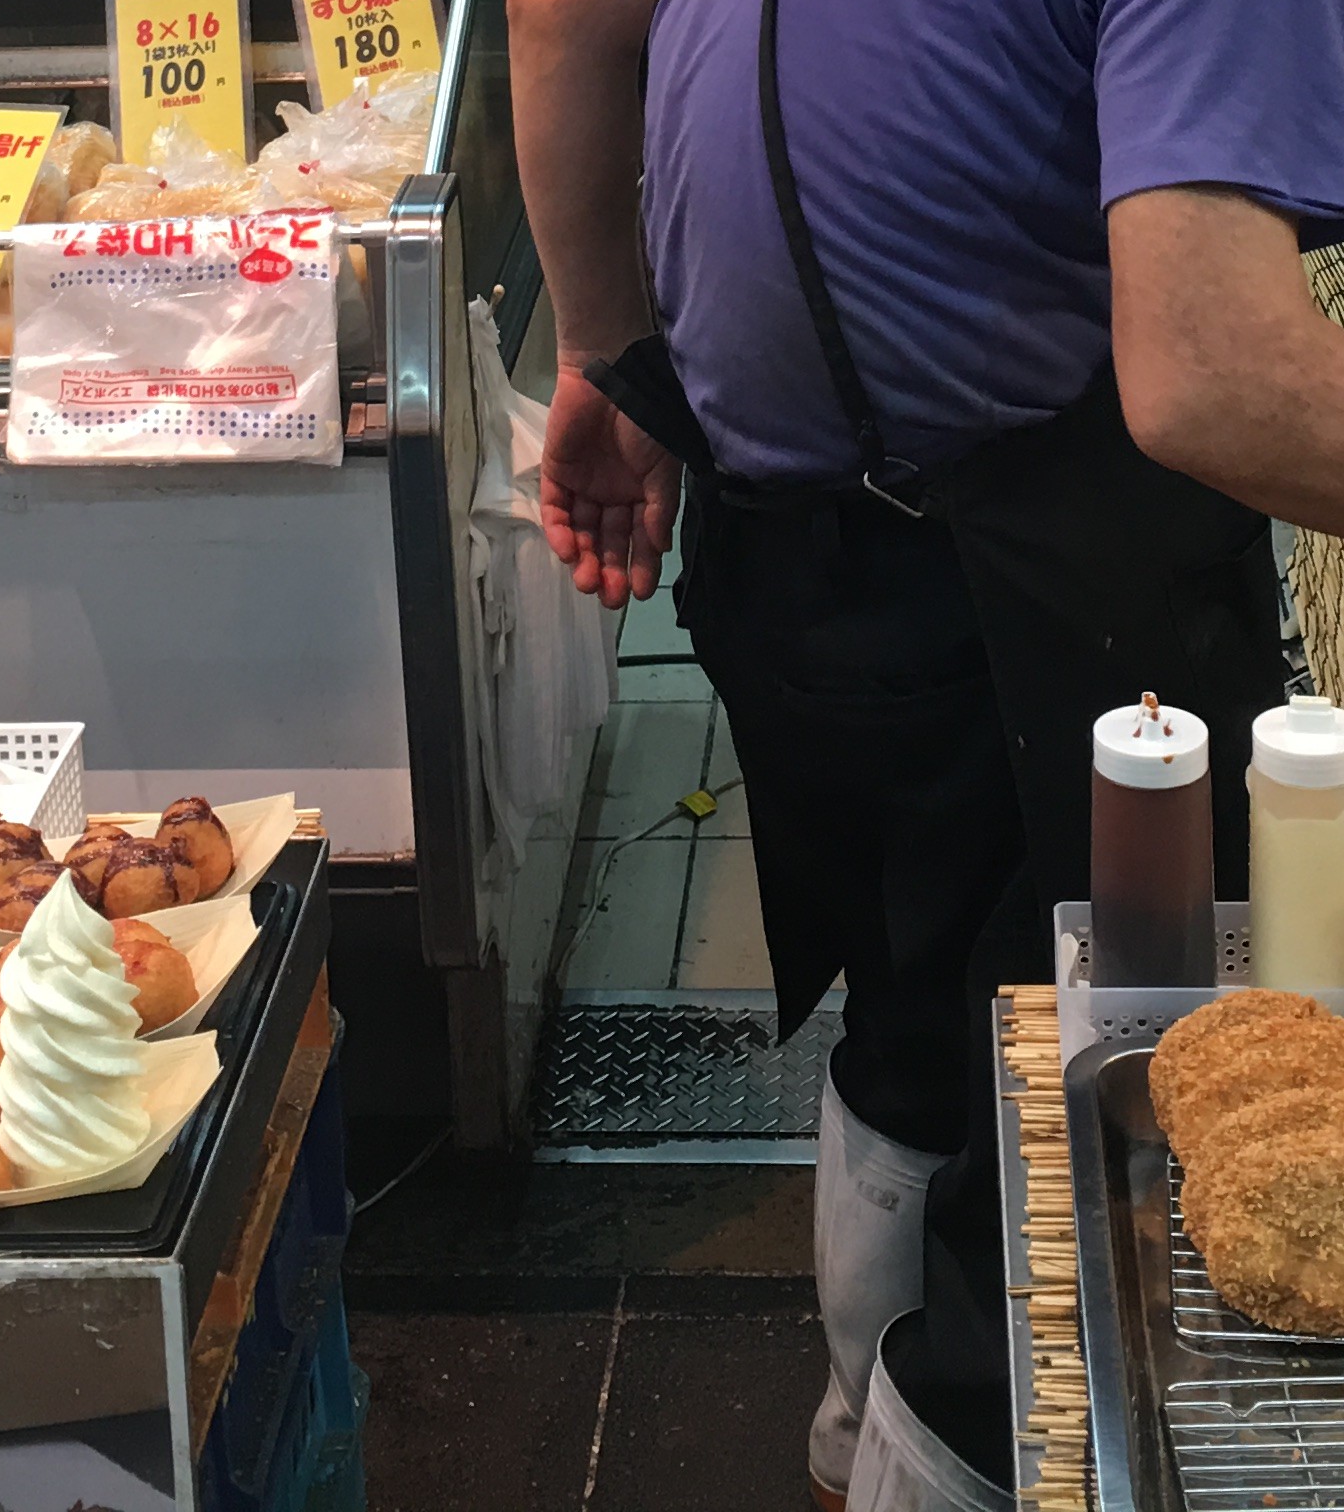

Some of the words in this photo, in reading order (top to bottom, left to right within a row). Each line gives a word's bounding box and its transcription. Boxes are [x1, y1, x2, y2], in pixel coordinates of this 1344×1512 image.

[347, 10, 394, 31] 10枚入
[144, 42, 218, 62] 1袋3枚入り
[334, 24, 401, 70] 180
[141, 59, 206, 99] 100
